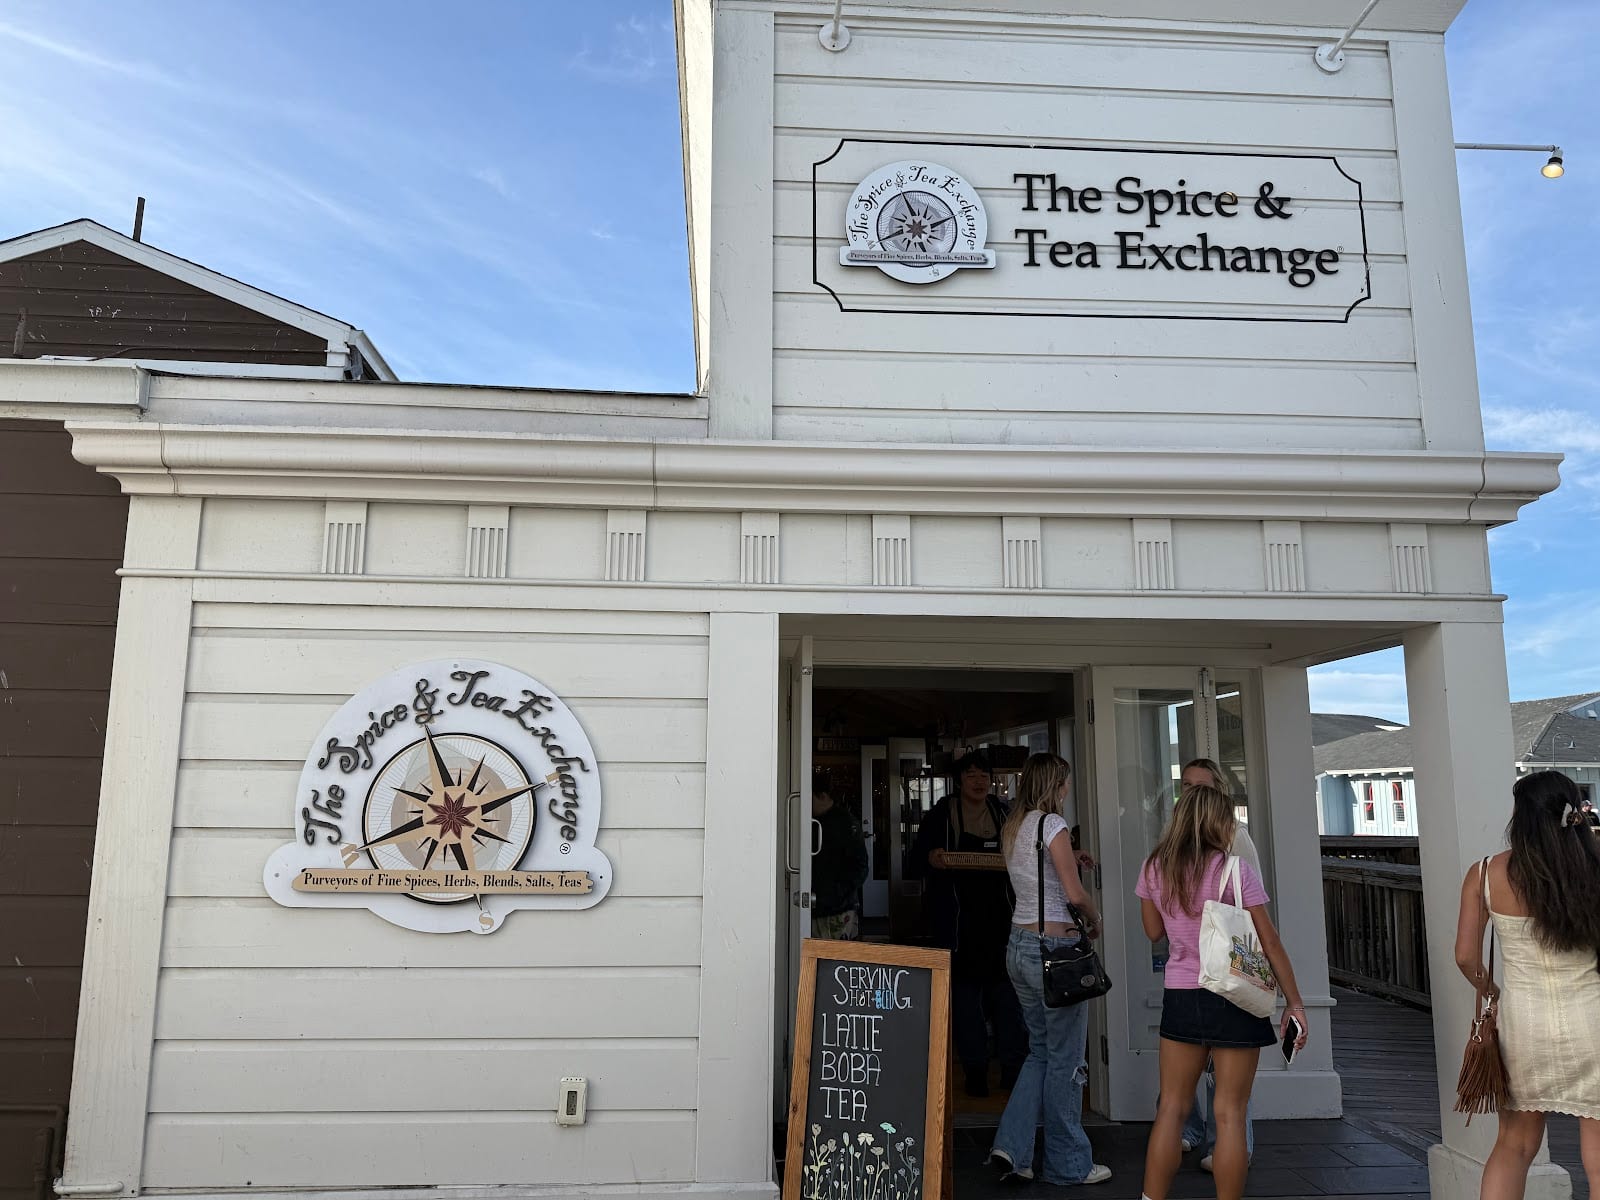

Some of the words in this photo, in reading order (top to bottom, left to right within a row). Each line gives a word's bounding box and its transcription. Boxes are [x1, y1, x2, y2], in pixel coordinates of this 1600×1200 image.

[895, 170, 907, 188] &
[908, 165, 937, 185] Tea
[854, 178, 892, 211] Spice
[1014, 173, 1102, 213] The
[1116, 176, 1239, 228] Spice
[1254, 181, 1293, 219] &
[848, 213, 869, 242] The
[1015, 229, 1100, 268] Tea
[413, 678, 444, 725] &
[447, 670, 506, 712] Tea
[317, 703, 408, 774] Spice
[302, 784, 345, 846] The
[304, 872, 359, 889] Purveyors
[361, 874, 374, 887] of
[377, 873, 402, 887] Fine
[404, 874, 441, 890] Spices,
[444, 875, 480, 889] Herbs,
[483, 875, 522, 889] Blends,
[525, 875, 554, 890] Salts,
[558, 875, 582, 888] Teas
[832, 965, 913, 1009] SERVING
[848, 988, 872, 1007] HOT
[822, 1013, 883, 1052] LATTE
[821, 1051, 882, 1086] BOBA
[820, 1086, 868, 1122] TEA
